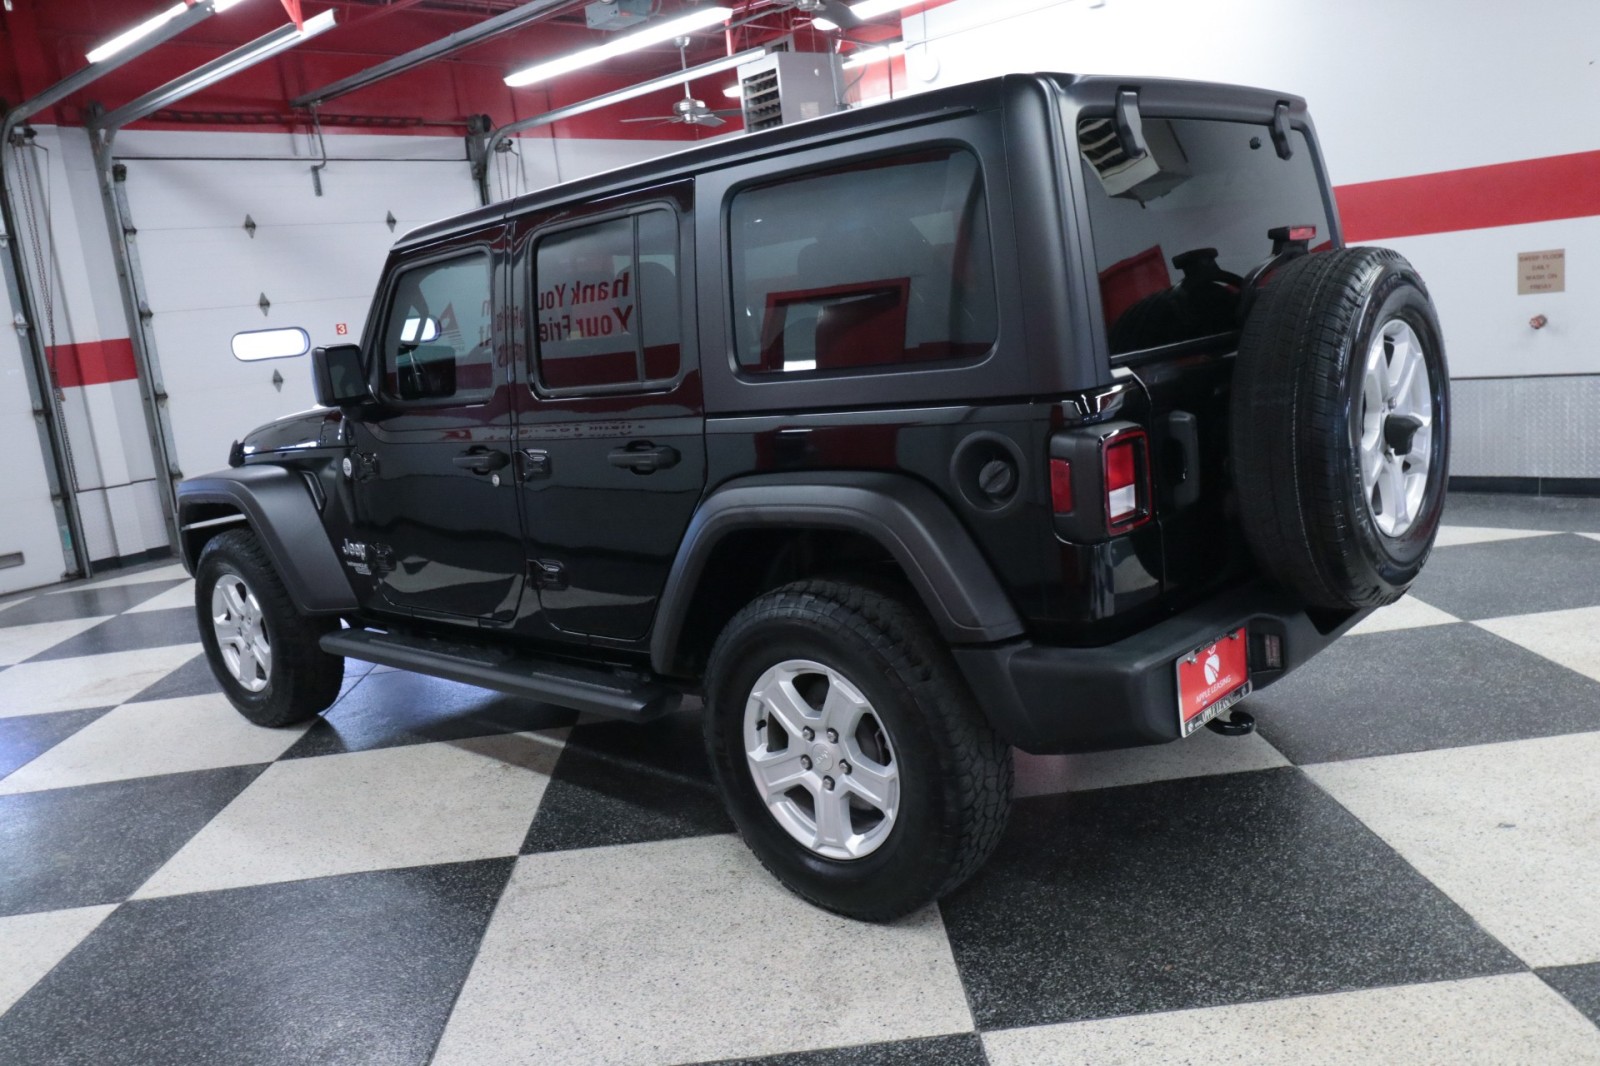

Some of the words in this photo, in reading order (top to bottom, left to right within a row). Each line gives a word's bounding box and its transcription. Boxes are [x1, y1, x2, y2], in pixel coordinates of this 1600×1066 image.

[337, 324, 346, 335] 3
[342, 537, 366, 561] Jeep
[1211, 674, 1232, 694] LEASING
